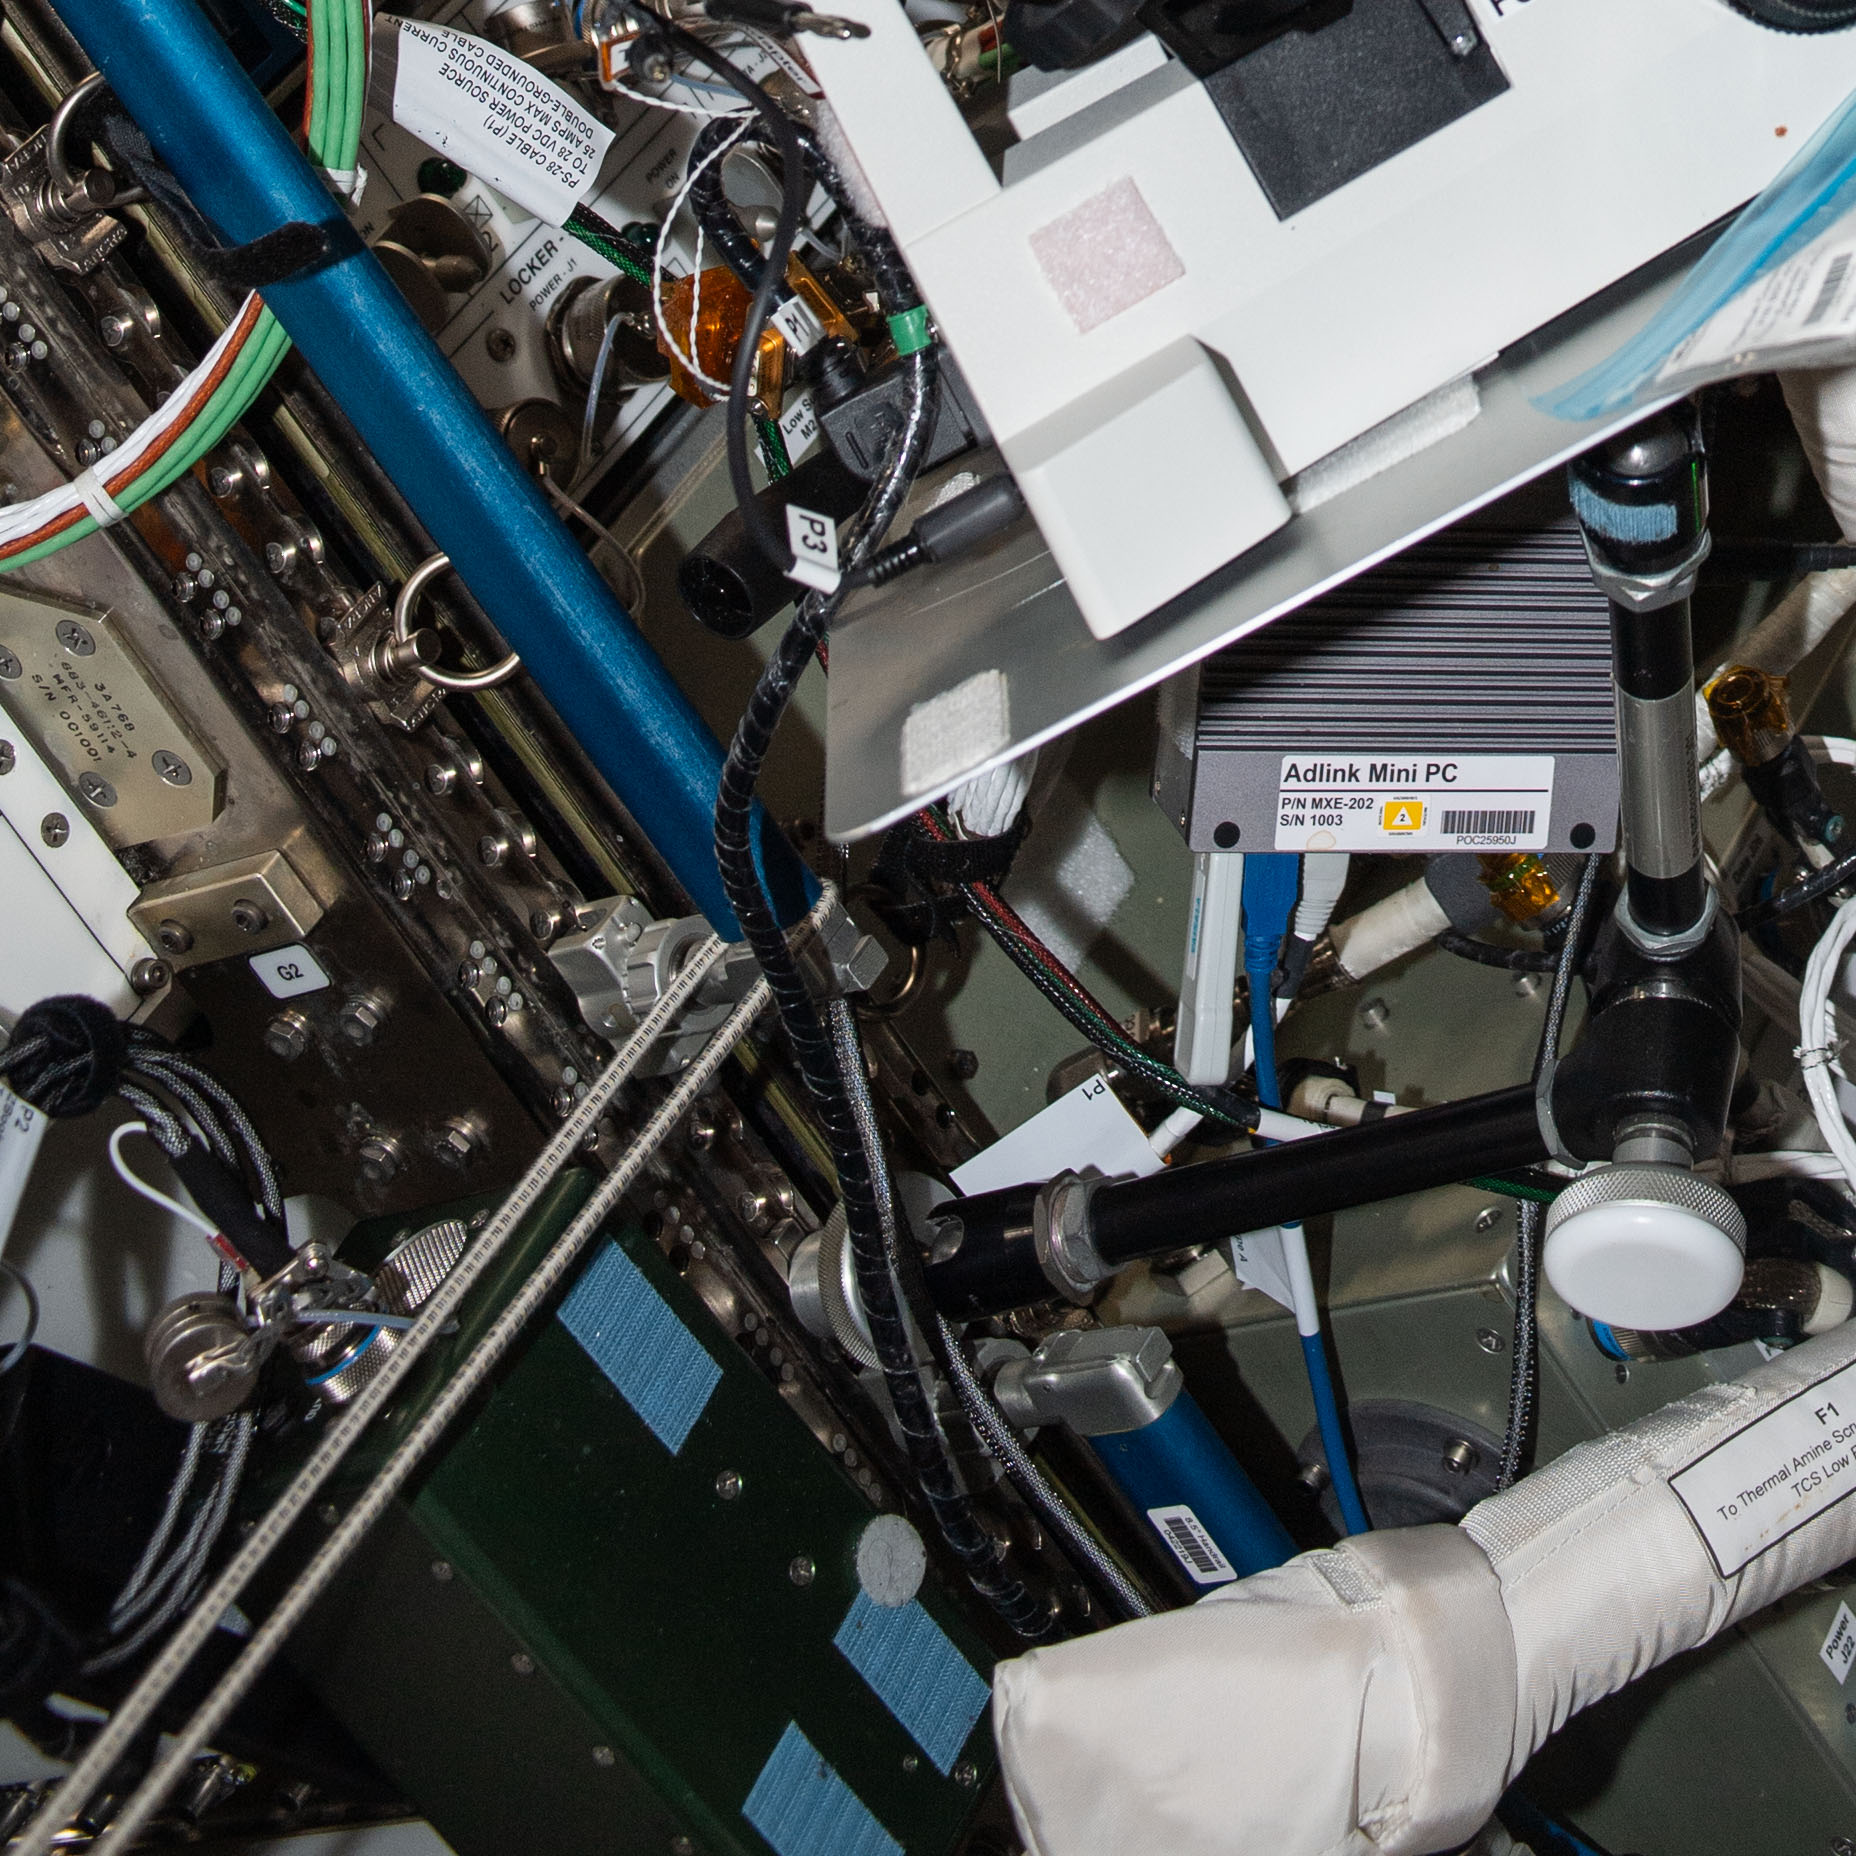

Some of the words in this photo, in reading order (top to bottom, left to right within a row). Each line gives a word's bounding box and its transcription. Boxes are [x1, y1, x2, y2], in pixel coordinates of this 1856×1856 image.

[384, 12, 449, 54] CURRENT
[442, 30, 484, 57] CABLE
[439, 63, 489, 103] SOURCE
[449, 49, 524, 105] CONTINUOUS
[486, 55, 593, 139] DOUBLE-GROUNDED
[483, 115, 508, 137] (P1)
[488, 98, 533, 133] POWER
[525, 101, 551, 127] MAX
[532, 129, 556, 152] VDC
[549, 120, 583, 148] AMPS
[506, 133, 546, 165] CABLE
[556, 146, 573, 161] 28
[581, 143, 596, 159] 25
[546, 162, 579, 188] PS-28
[572, 157, 587, 175] TO
[643, 147, 680, 186] POWER
[500, 239, 560, 304] LOCKER
[527, 276, 562, 313] POWER
[565, 258, 578, 272] J1
[785, 307, 812, 345] P1
[781, 410, 805, 434] Low
[798, 416, 821, 441] M2
[800, 511, 827, 553] P3
[32, 672, 56, 701] S/N
[1284, 763, 1359, 782] Adlink
[1368, 763, 1417, 782] Mini
[1426, 763, 1457, 782] PC
[1280, 797, 1307, 809] P/N
[1309, 797, 1375, 809] MXE-202
[1280, 814, 1305, 826] S/N
[1311, 814, 1342, 826] 1003
[1399, 812, 1405, 823] 2
[1456, 834, 1517, 846] POC25950J
[277, 964, 303, 981] G2
[1082, 1079, 1105, 1100] P1
[15, 1104, 35, 1133] P2
[1815, 1403, 1839, 1425] F1
[1717, 1502, 1738, 1520] To
[1737, 1465, 1791, 1505] Thermal
[1793, 1440, 1832, 1472] Amine
[1791, 1471, 1822, 1497] TCS
[1822, 1455, 1849, 1478] Low
[1196, 1533, 1225, 1568] Handrail
[1823, 1615, 1854, 1659] Power
